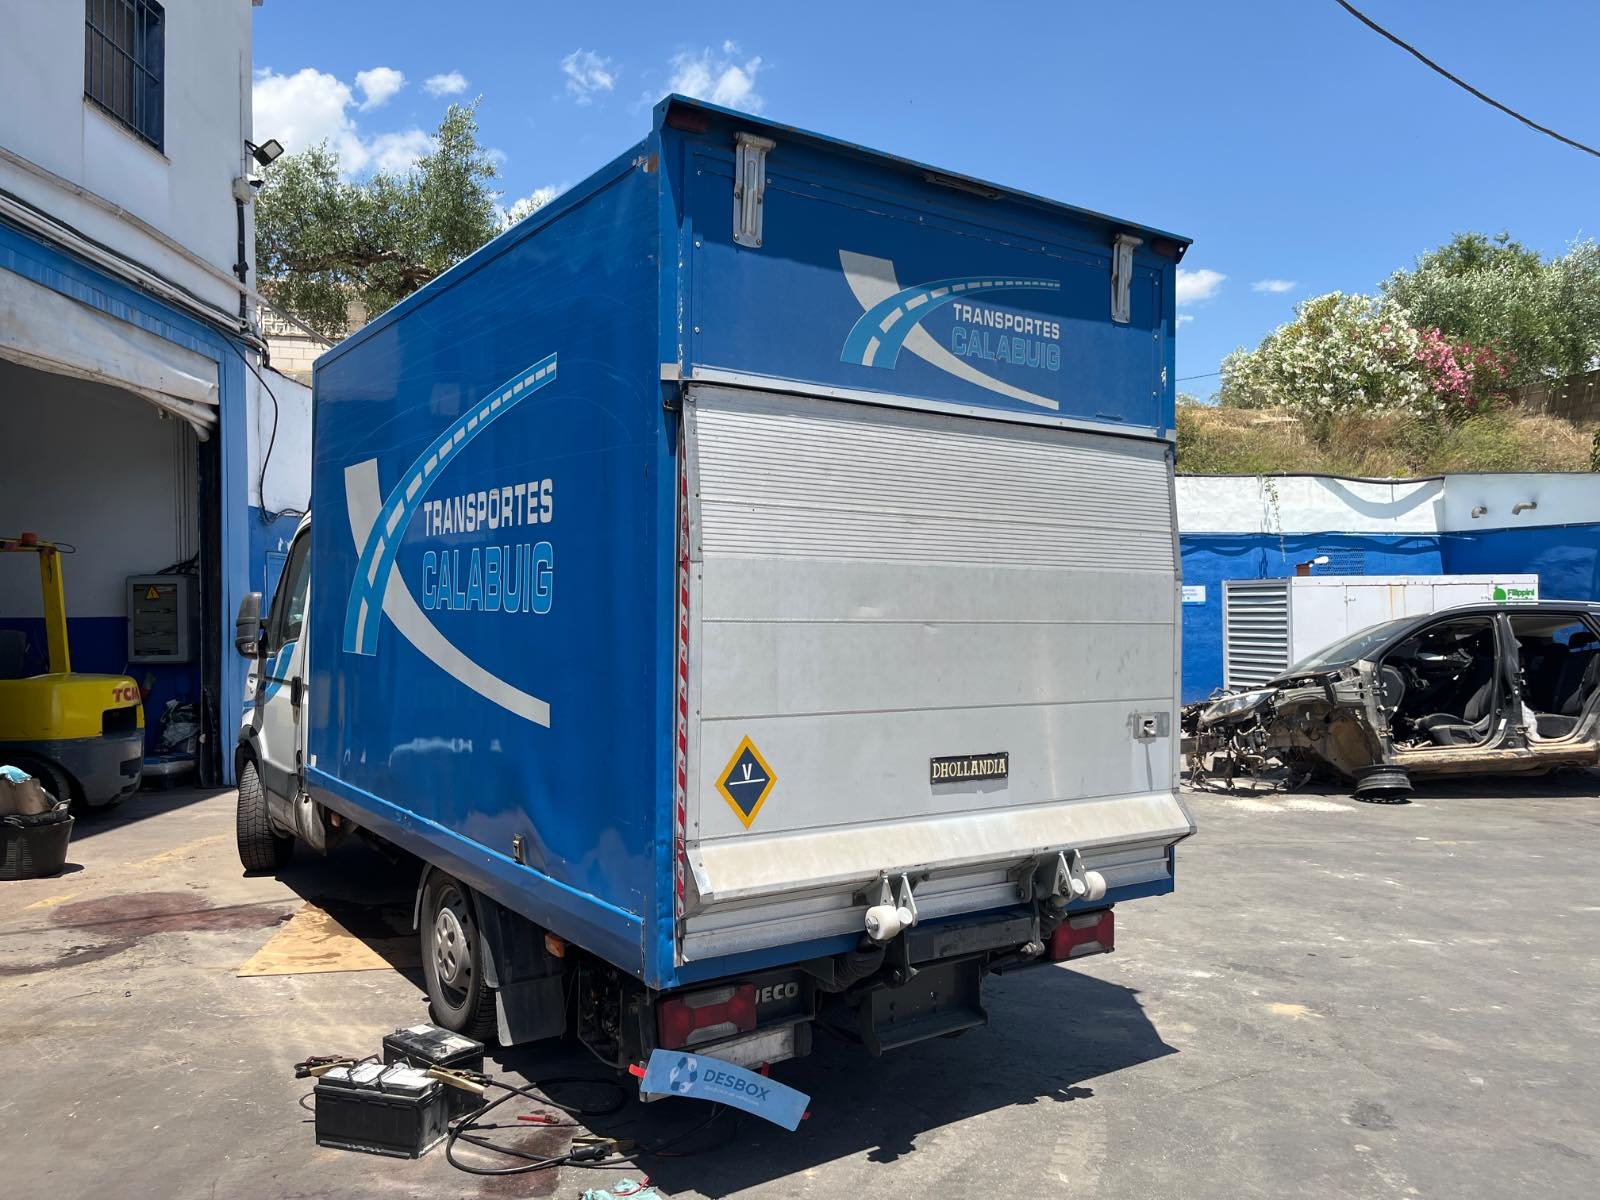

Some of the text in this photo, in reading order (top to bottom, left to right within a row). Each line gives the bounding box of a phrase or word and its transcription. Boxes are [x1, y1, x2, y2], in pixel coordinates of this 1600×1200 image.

[953, 303, 1061, 340] TRANSPORTES
[952, 327, 1061, 371] CALABUIG
[423, 478, 553, 537] TRANSPORTES
[422, 541, 554, 615] CALABUIG
[742, 763, 752, 781] V
[932, 758, 1007, 778] DHOLLANDIA
[703, 1069, 771, 1101] DESBOX
